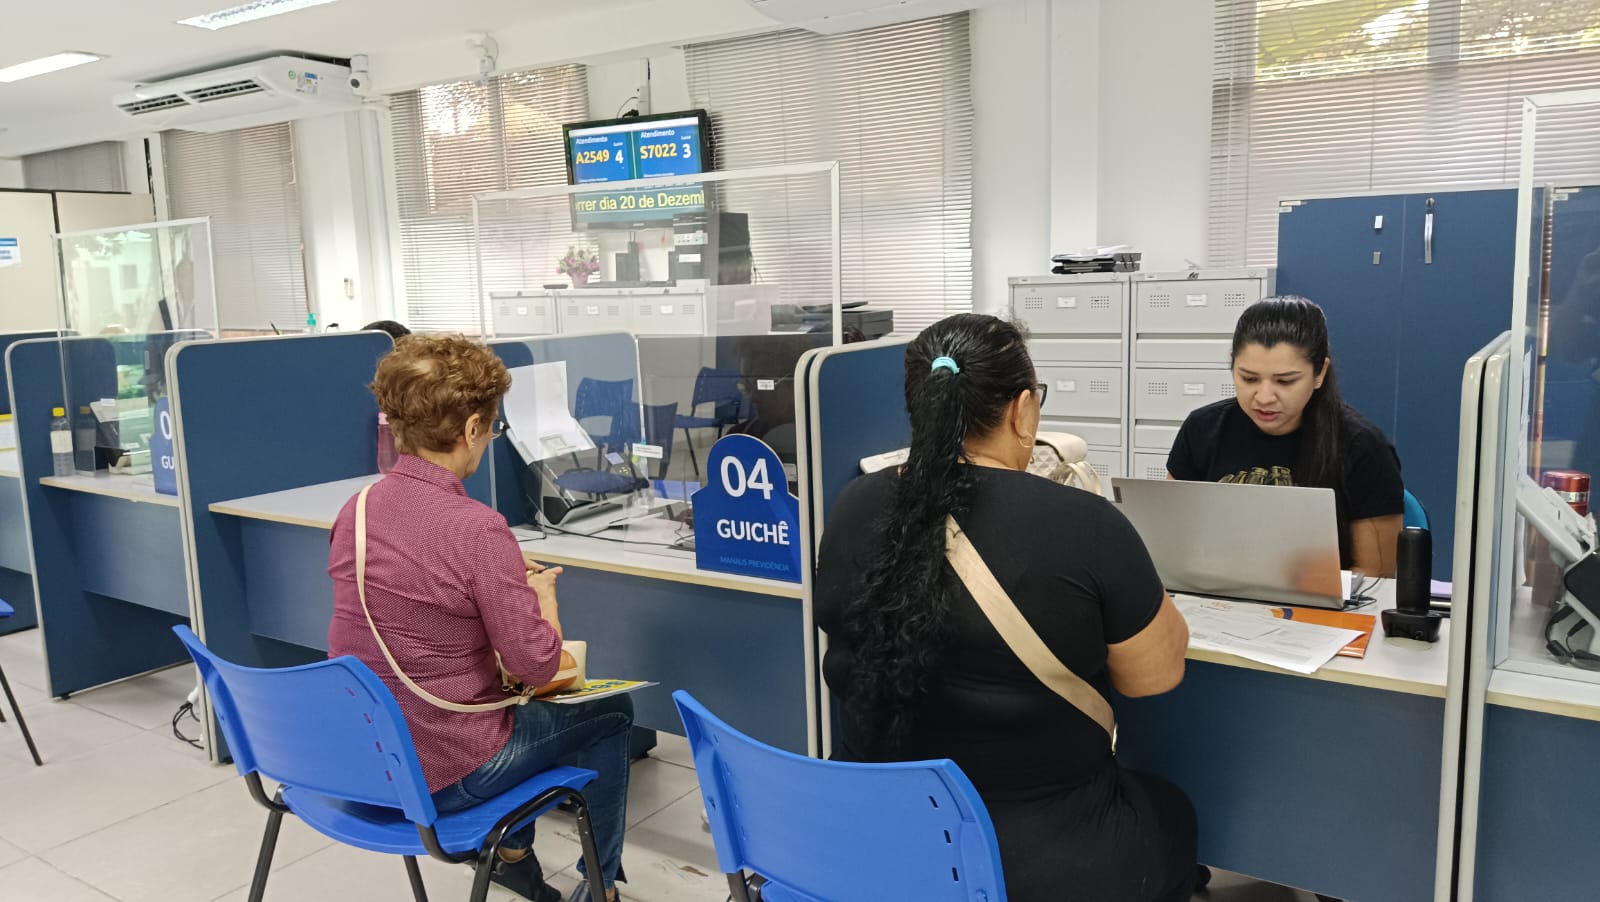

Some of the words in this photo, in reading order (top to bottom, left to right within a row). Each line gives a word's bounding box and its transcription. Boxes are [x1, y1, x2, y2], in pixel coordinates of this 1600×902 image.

[576, 136, 608, 145] Atendimento
[640, 129, 675, 139] Atendimento
[575, 149, 610, 164] A2549
[615, 149, 624, 164] 4
[640, 143, 678, 159] S7022
[682, 143, 692, 159] 3
[599, 196, 618, 210] dia
[620, 195, 636, 209] 20
[638, 194, 655, 208] de
[720, 455, 774, 500] 04
[716, 518, 790, 545] GUICHÊ
